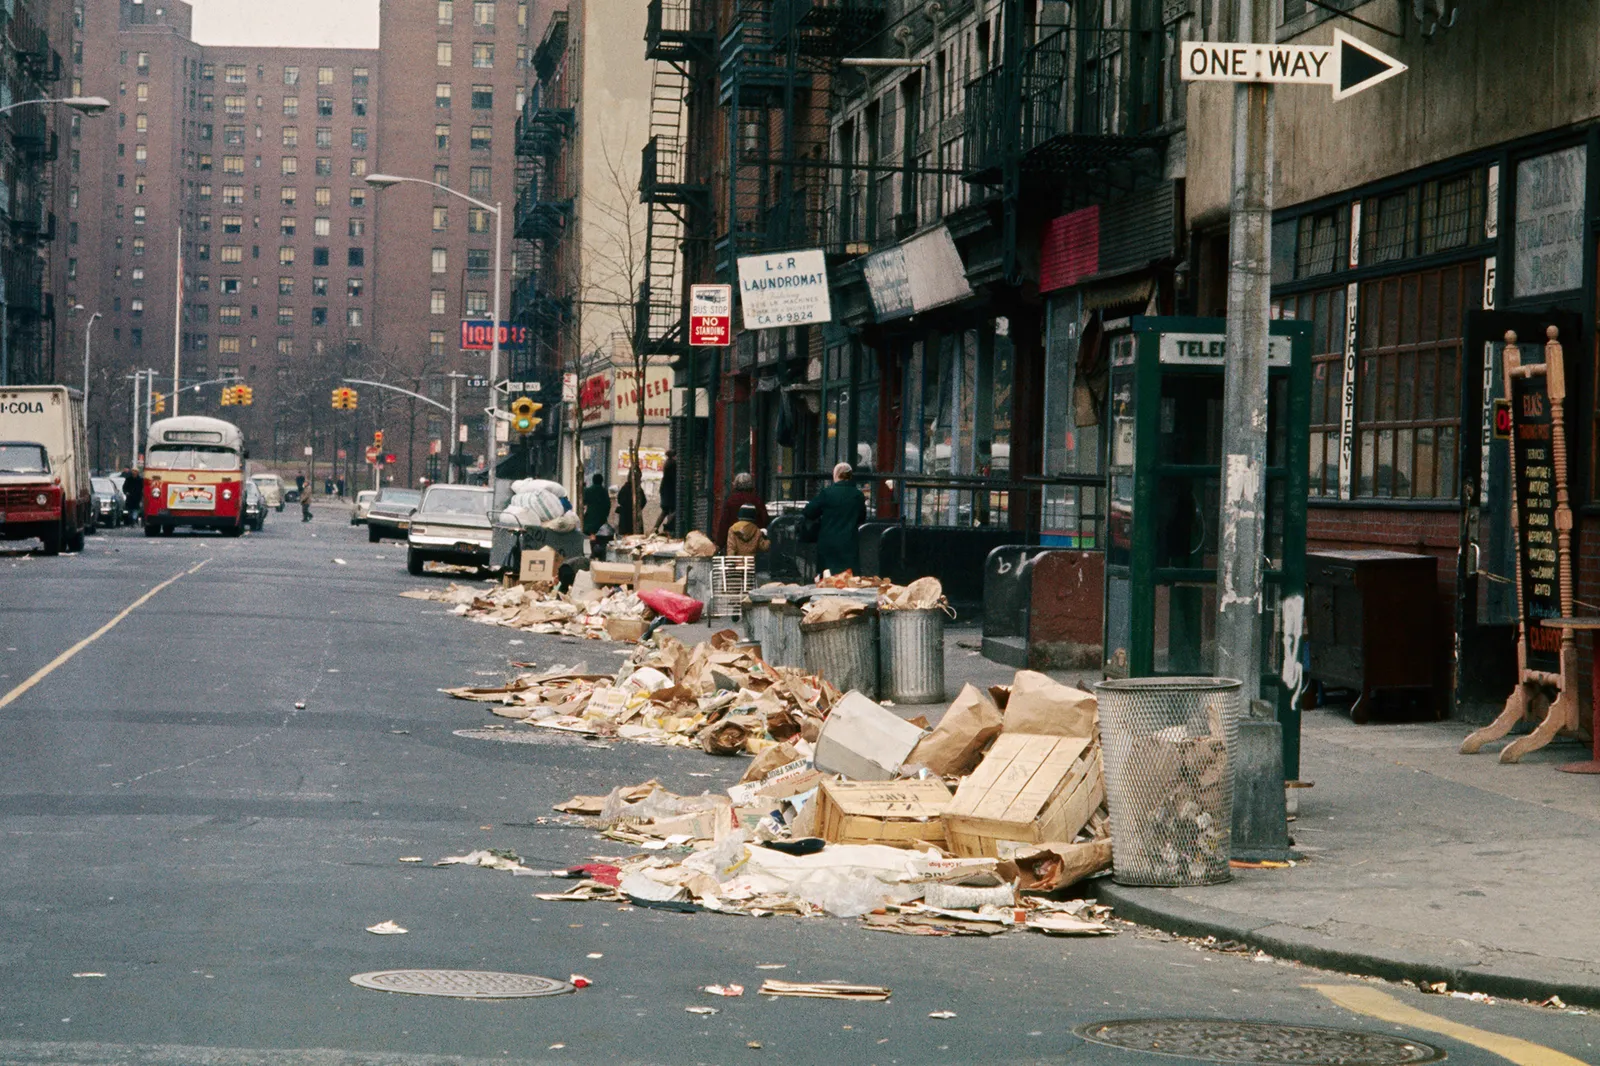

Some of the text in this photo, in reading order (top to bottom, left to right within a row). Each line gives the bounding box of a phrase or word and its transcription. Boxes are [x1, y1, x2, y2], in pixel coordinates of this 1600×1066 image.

[1190, 48, 1329, 77] ONE WAY
[766, 260, 773, 271] L
[787, 257, 796, 269] R
[743, 273, 823, 291] LAUNDROMAT
[693, 305, 728, 314] BUS STOP
[702, 317, 719, 326] NO
[776, 311, 813, 323] 8-9824
[695, 326, 725, 336] STANDING
[1176, 340, 1275, 359] TELEPE
[1482, 268, 1496, 446] FUITURE
[1343, 305, 1356, 470] UPHOLSTERY
[767, 768, 784, 778] FRUI
[786, 759, 807, 773] NEVINS
